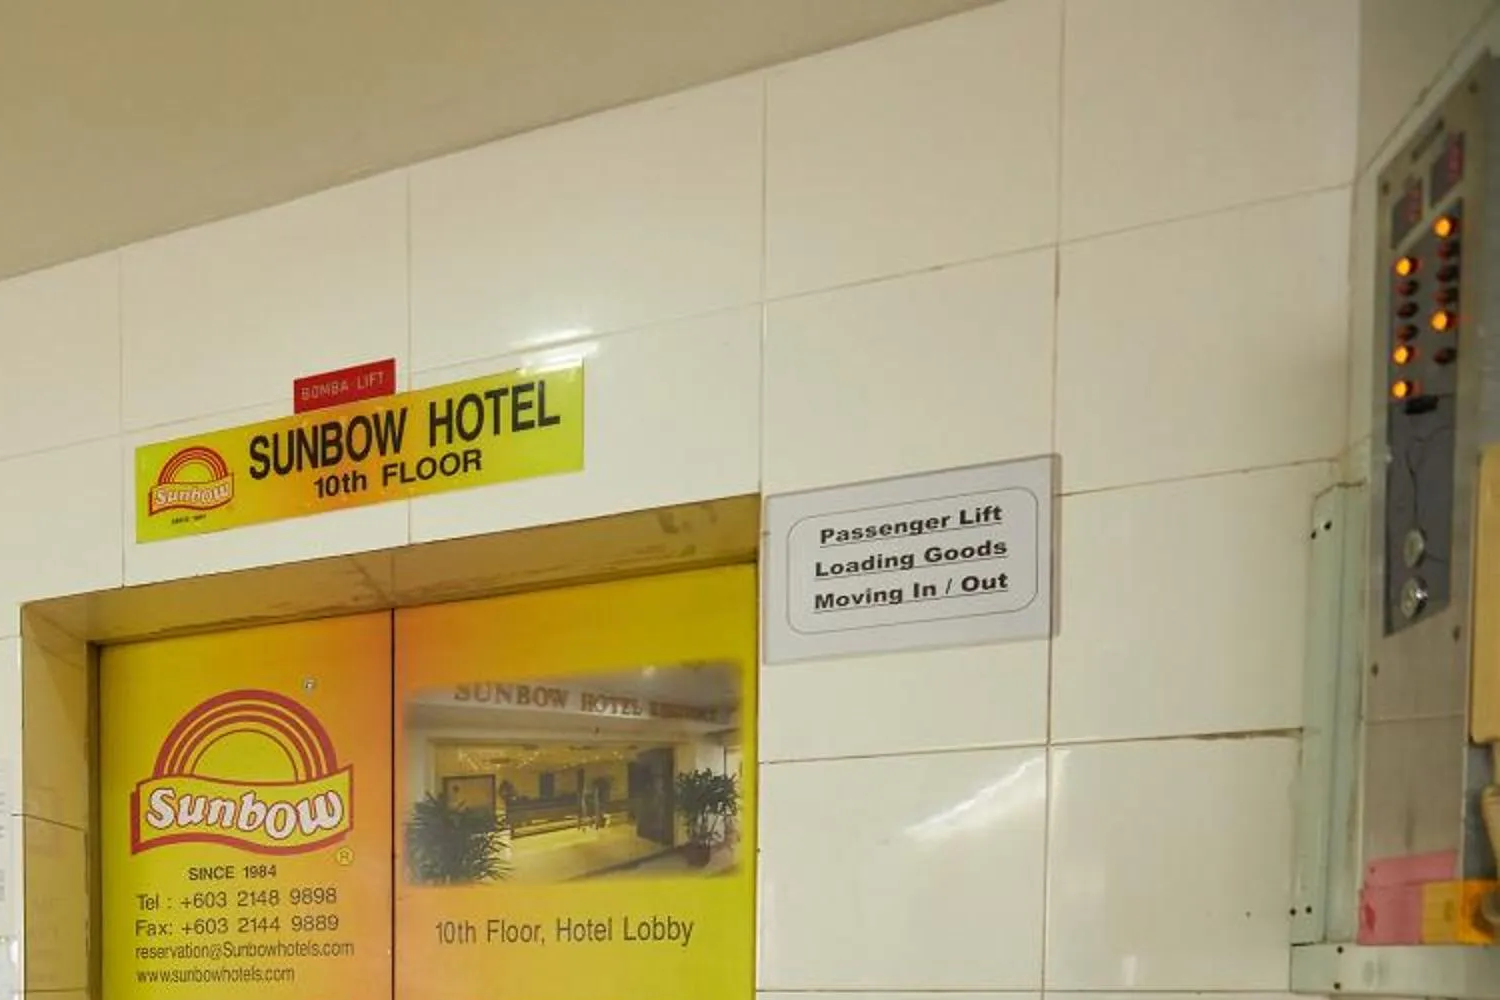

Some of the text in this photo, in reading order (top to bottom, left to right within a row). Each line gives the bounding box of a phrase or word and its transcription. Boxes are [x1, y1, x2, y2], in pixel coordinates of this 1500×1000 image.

[301, 371, 385, 400] BOMBA LIFT
[248, 379, 561, 480] SUNBOW HOTEL
[314, 448, 483, 498] 10th FLOOR
[155, 483, 229, 505] Sunbow
[820, 505, 1003, 545] Passenger Lift
[815, 540, 1008, 577] Loading Goods
[815, 572, 1008, 610] Moving In / Out
[454, 681, 570, 709] SUNBOW
[581, 692, 643, 716] HOTEL
[146, 787, 344, 840] Sunbow
[188, 864, 277, 882] SINCE 1984
[137, 893, 159, 911] Tel
[180, 890, 227, 909] +603
[237, 889, 280, 907] 2148
[290, 886, 338, 905] 9898
[135, 914, 339, 937] Fax: +603 2144 9889
[435, 916, 695, 946] 10th Floor, Hotel Lobby
[136, 965, 295, 983] www.sunbowhotels.com
